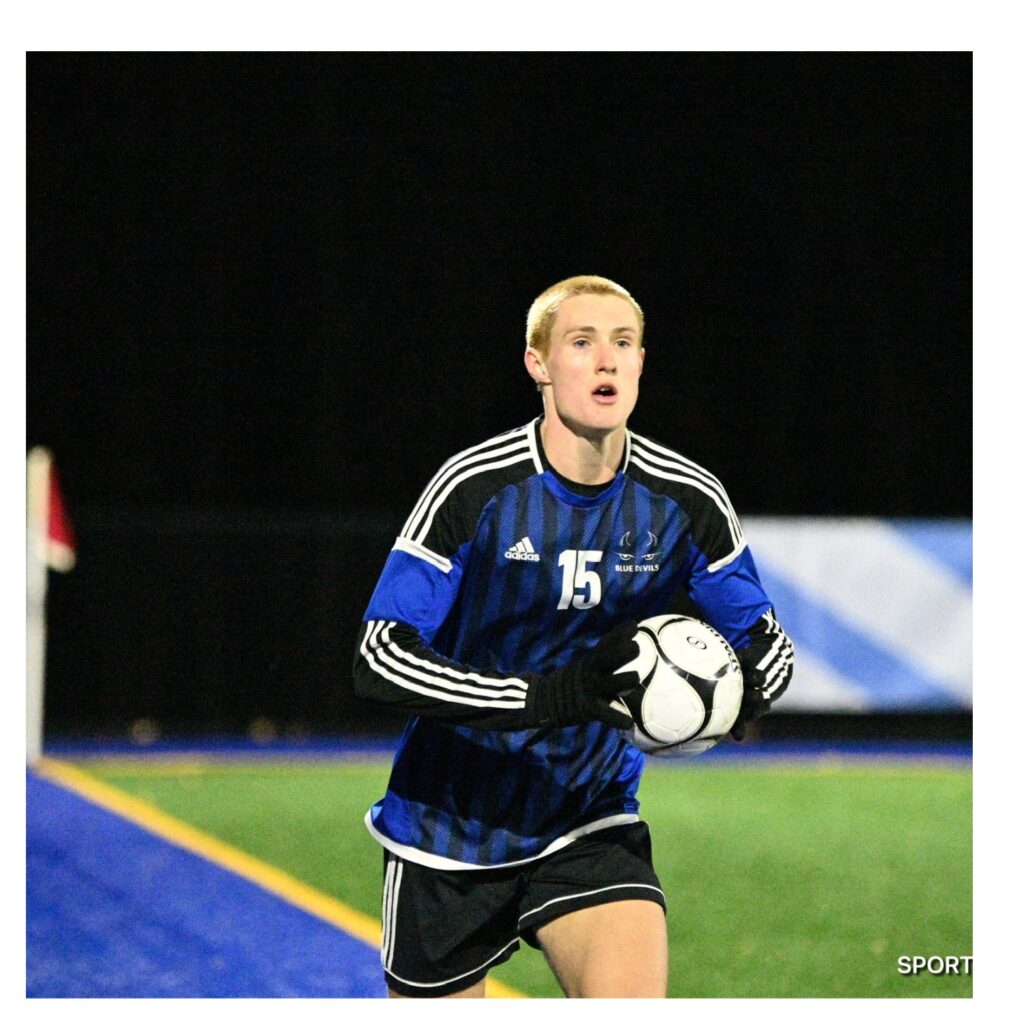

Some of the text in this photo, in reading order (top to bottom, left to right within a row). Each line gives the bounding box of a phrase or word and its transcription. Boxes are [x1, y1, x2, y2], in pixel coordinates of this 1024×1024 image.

[504, 550, 540, 562] adidas
[615, 564, 660, 573] BLUE DEVILS
[556, 549, 604, 611] 15
